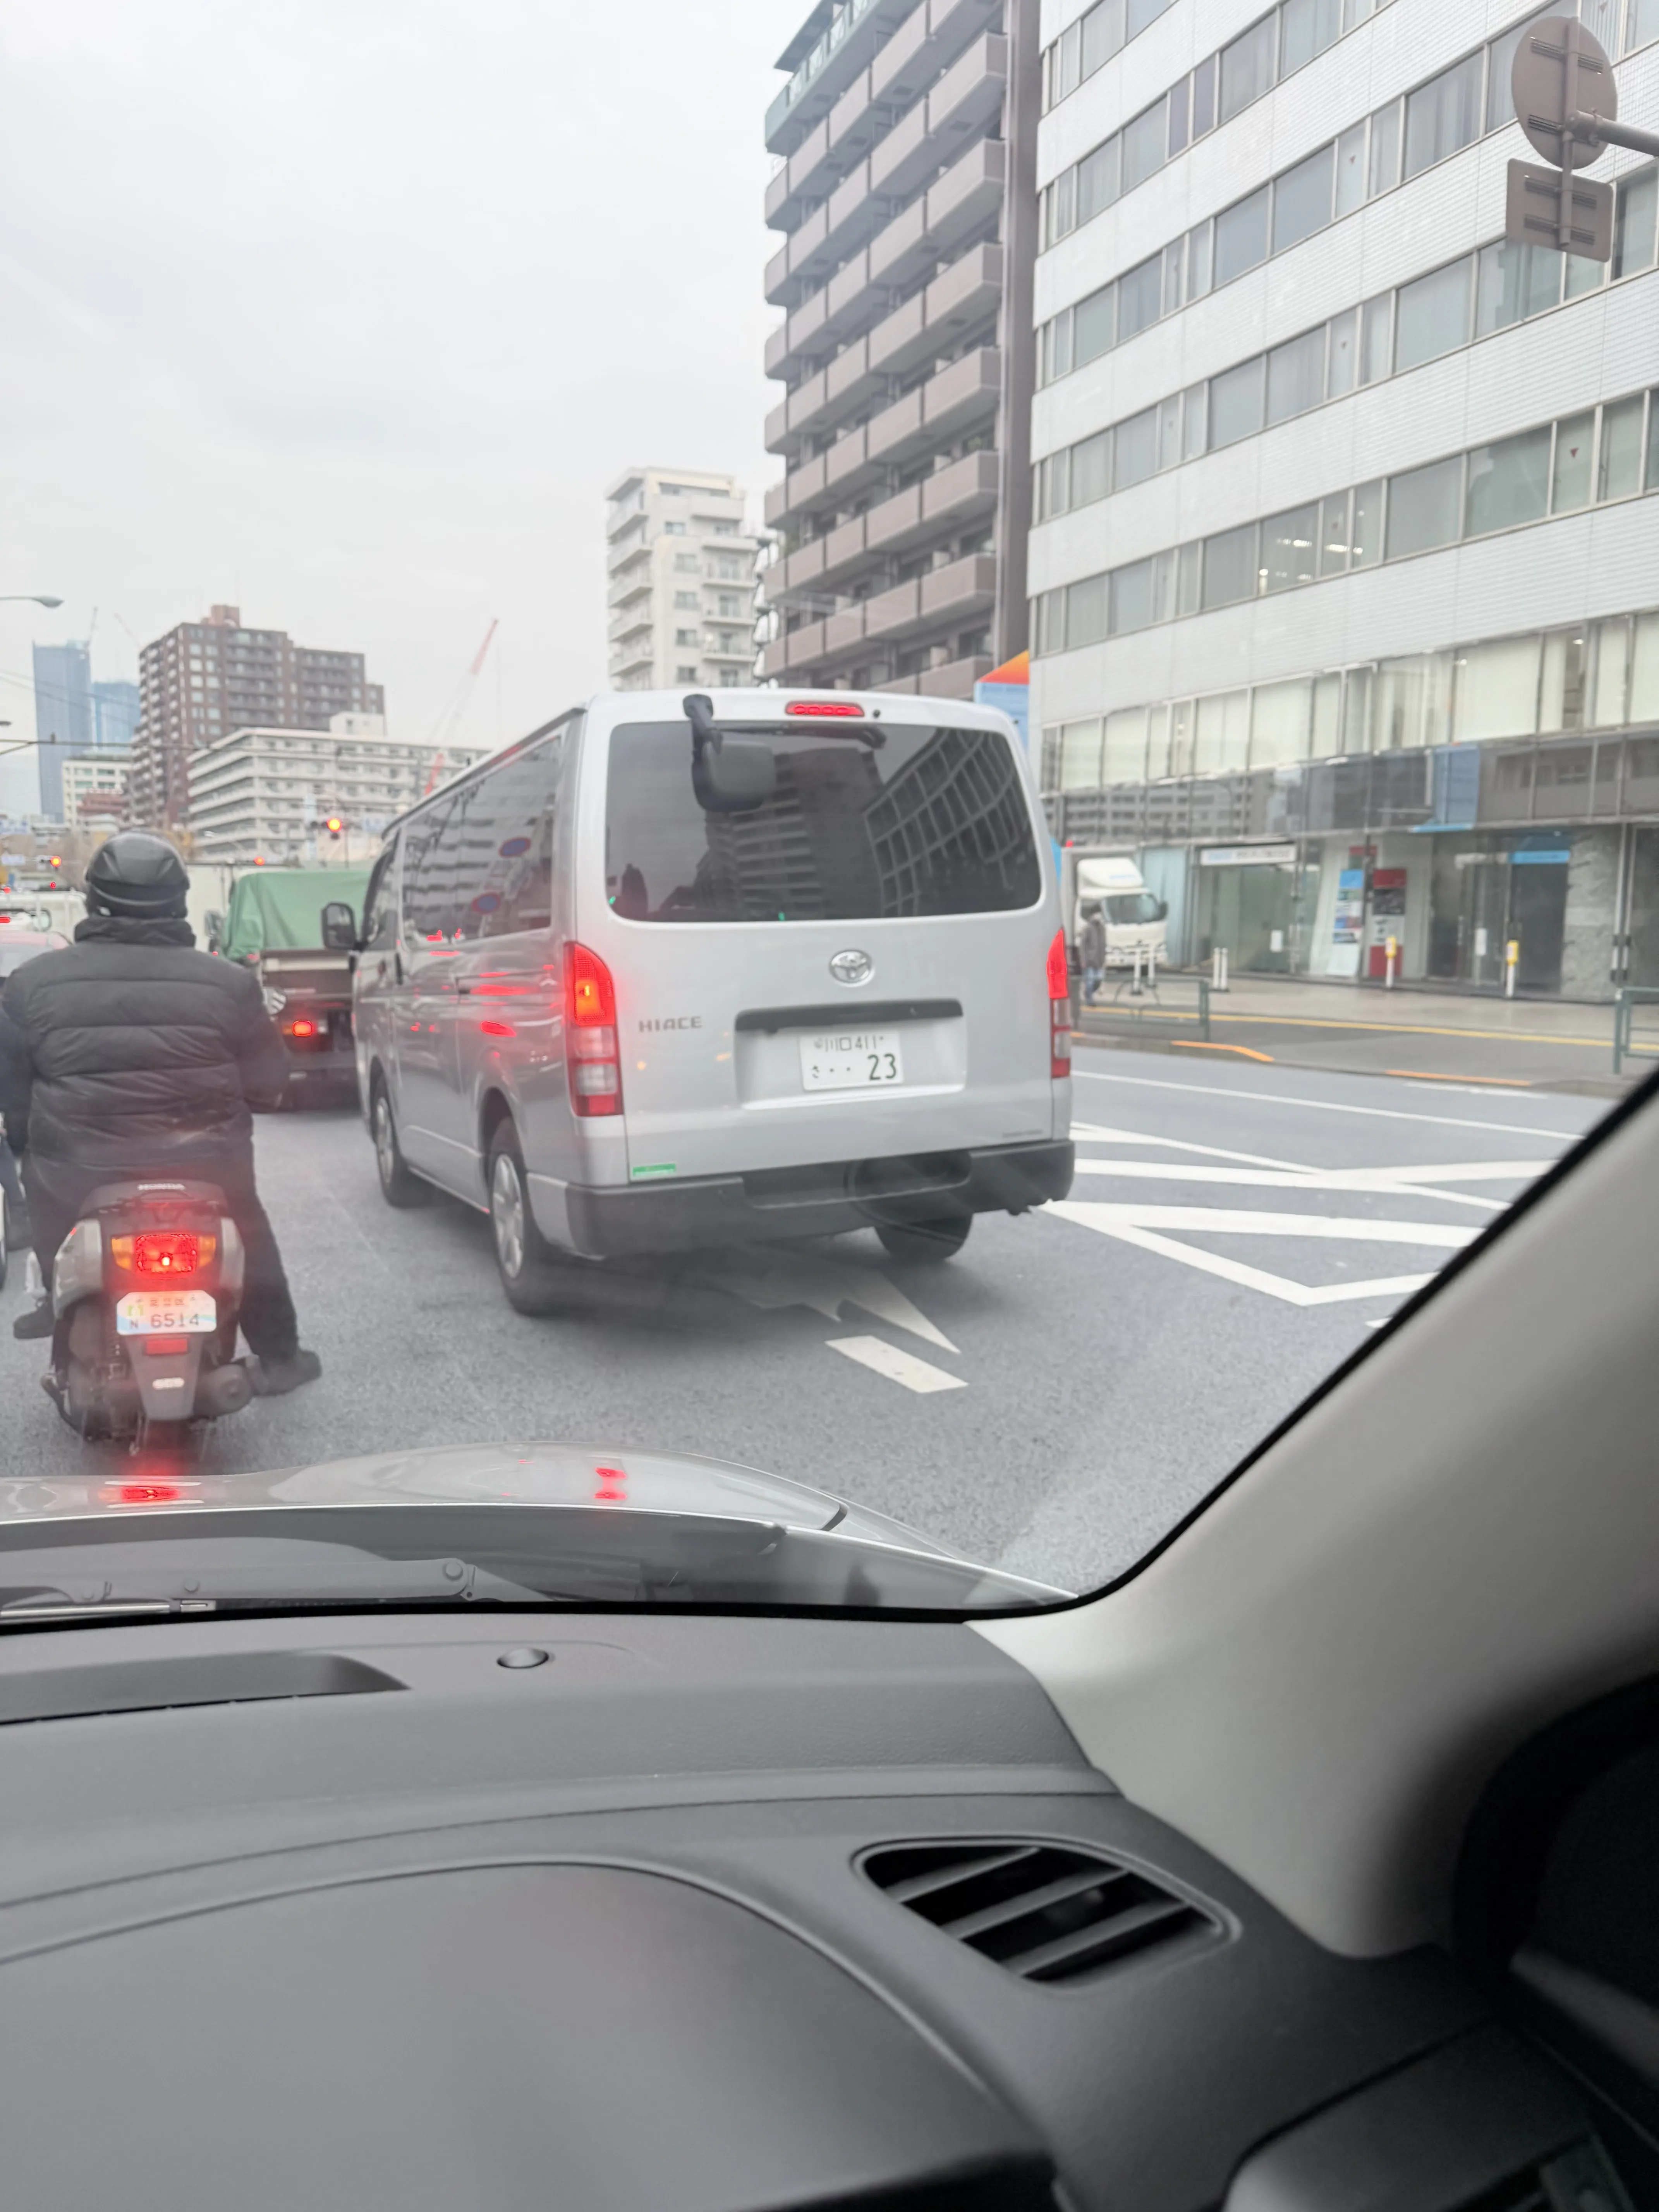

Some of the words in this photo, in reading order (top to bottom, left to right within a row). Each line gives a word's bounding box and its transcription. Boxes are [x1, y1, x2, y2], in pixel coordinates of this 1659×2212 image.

[639, 1016, 702, 1032] HIACE
[855, 1035, 877, 1050] 411
[151, 1312, 199, 1328] 6514
